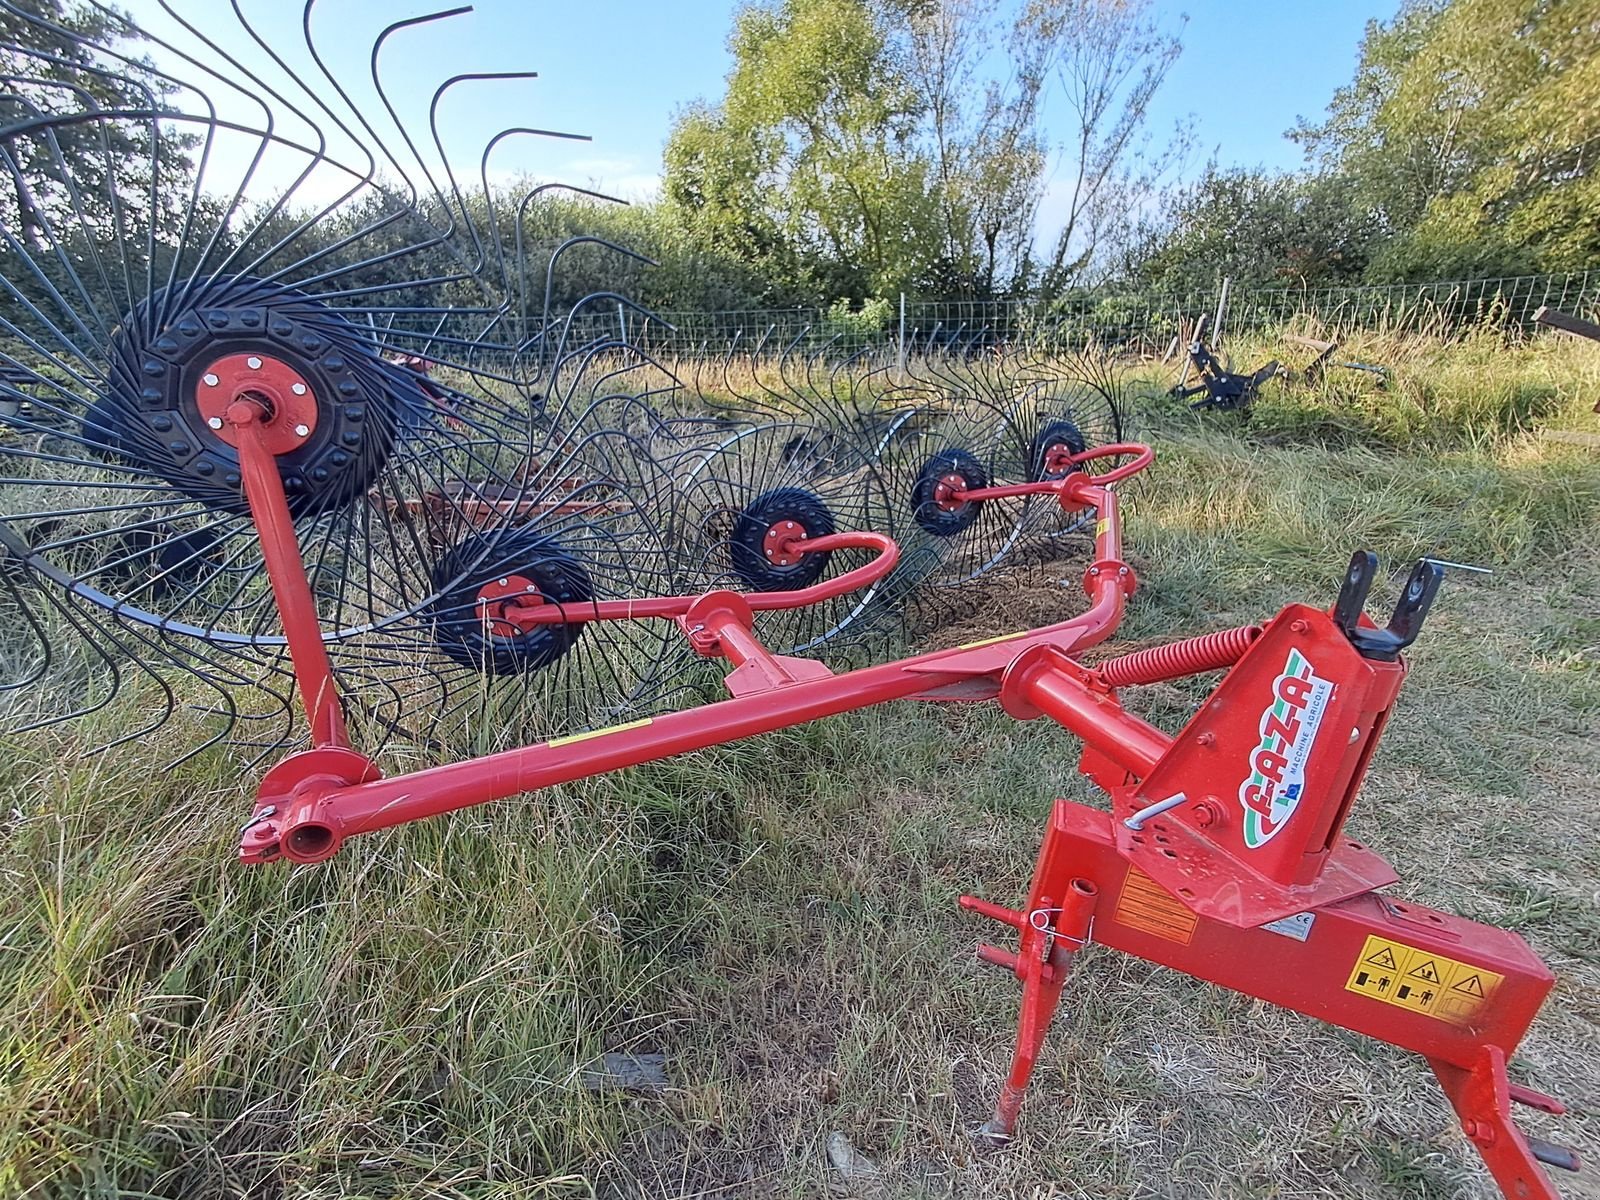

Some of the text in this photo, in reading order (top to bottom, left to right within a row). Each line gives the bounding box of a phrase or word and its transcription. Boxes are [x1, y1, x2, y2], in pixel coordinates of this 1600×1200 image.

[1290, 731, 1310, 776] MACCHINE
[1306, 684, 1326, 728] AGRICOLE
[1296, 915, 1310, 924] CE
